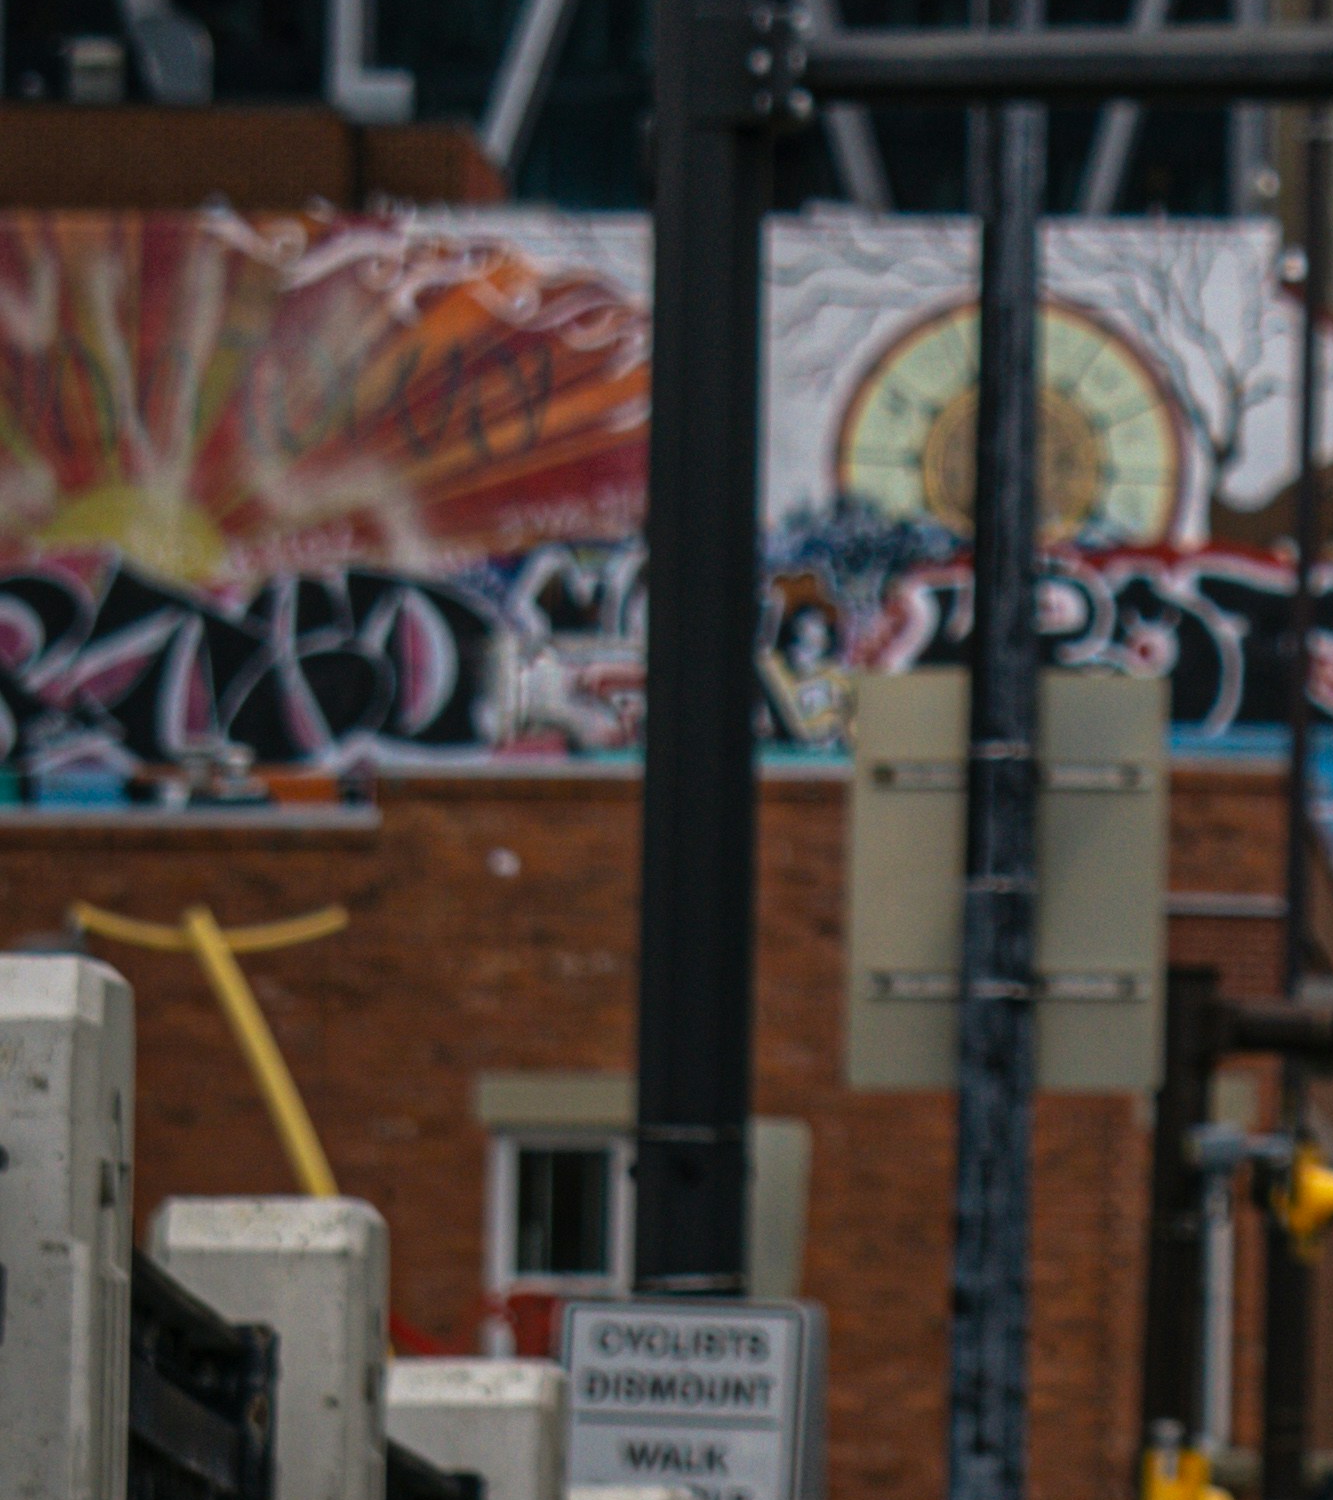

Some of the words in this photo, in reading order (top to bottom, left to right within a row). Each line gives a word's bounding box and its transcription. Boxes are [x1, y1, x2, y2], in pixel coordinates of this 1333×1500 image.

[590, 1318, 769, 1362] CYCLISTS
[580, 1366, 774, 1407] DISMOUNT
[622, 1436, 728, 1475] WALK
